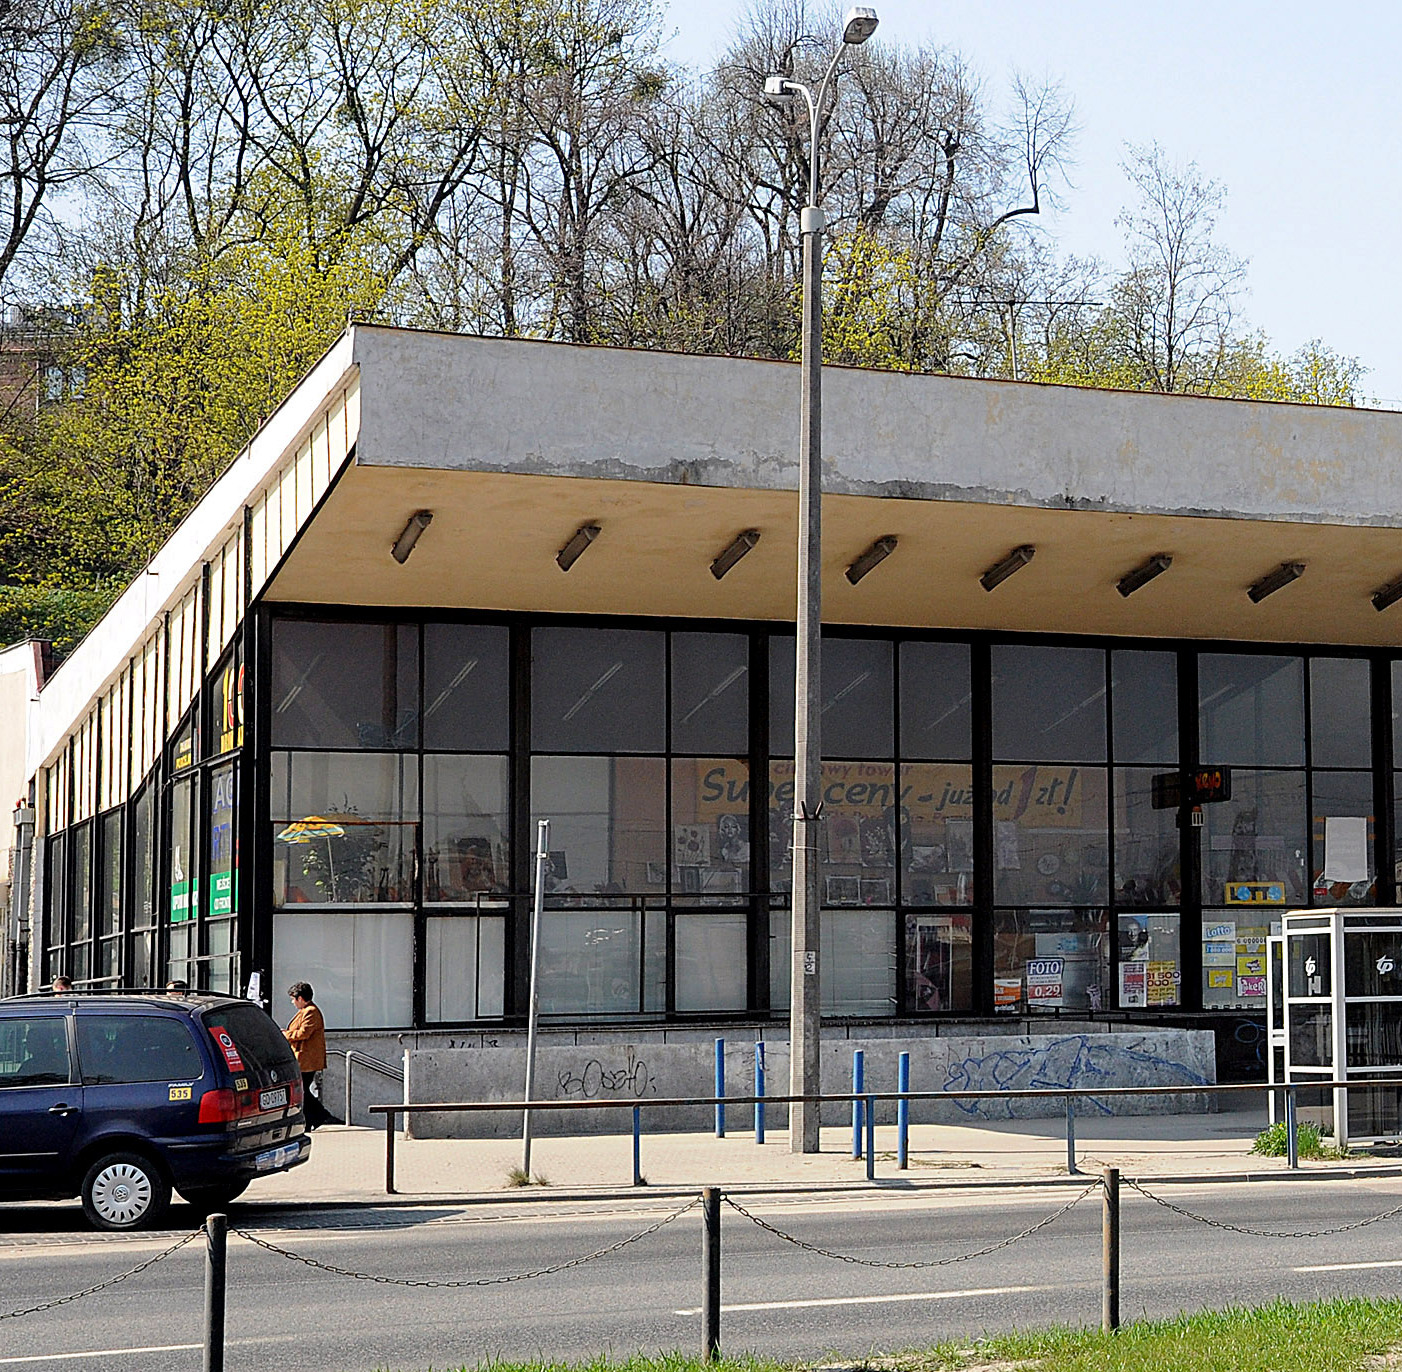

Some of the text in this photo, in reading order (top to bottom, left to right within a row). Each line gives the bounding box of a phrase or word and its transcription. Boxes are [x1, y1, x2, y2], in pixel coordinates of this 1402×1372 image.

[1206, 926, 1231, 938] Lotto
[1029, 961, 1060, 975] FOTO
[235, 1079, 248, 1090] 535
[171, 1089, 189, 1099] 535
